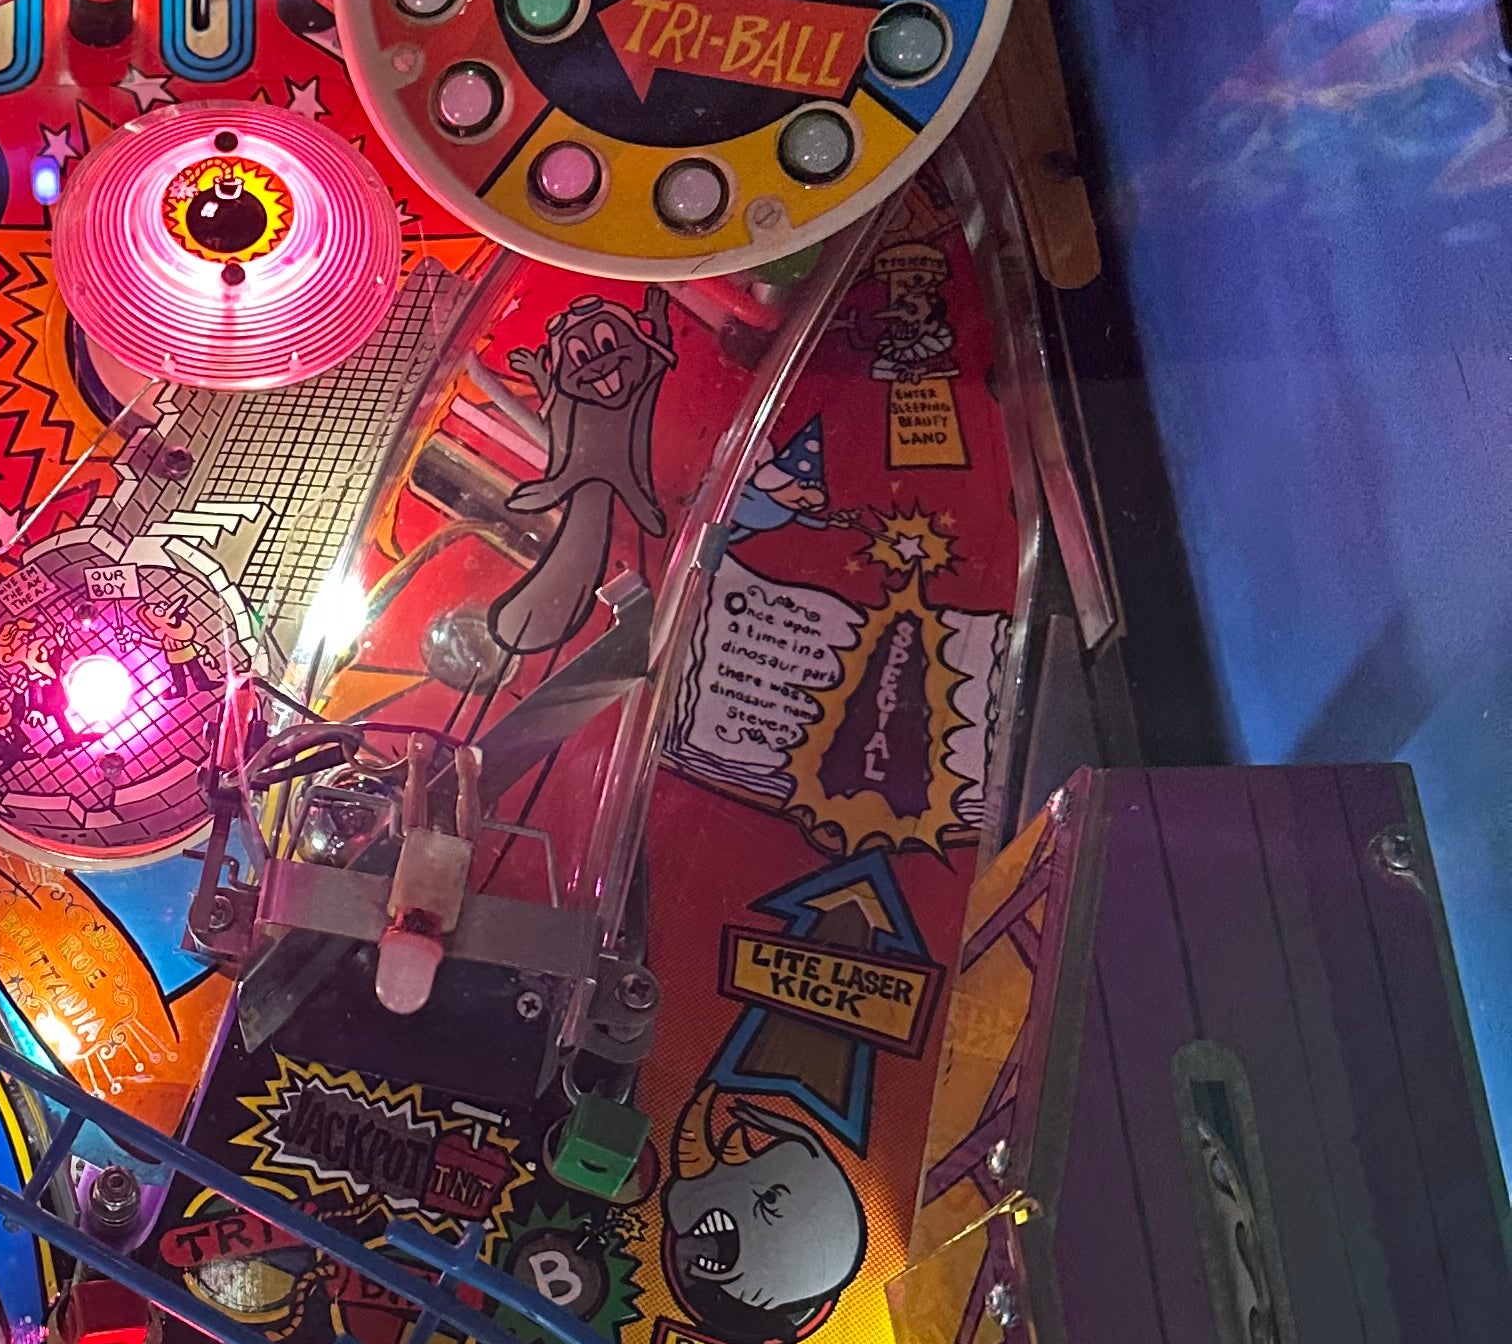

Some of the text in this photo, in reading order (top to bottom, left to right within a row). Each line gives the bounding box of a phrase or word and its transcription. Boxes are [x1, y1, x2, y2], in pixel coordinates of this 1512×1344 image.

[890, 402, 951, 415] SLEEPING
[895, 388, 937, 400] ENTER
[898, 416, 948, 428] BEAUTY
[898, 431, 948, 446] LAND
[3, 576, 43, 603] THE AX
[20, 566, 38, 584] EM
[90, 570, 128, 582] OUR
[91, 583, 126, 598] BOY
[11, 582, 50, 610] THE AX
[724, 591, 822, 637] Once upon
[727, 621, 825, 660] a time in a
[717, 662, 762, 688] there
[770, 680, 800, 701] was
[720, 640, 837, 686] dinosaur park
[709, 681, 777, 710] dinosaur
[863, 620, 915, 782] SPECIAL
[55, 933, 108, 990] RUE
[751, 943, 914, 1006] LITE LASER
[770, 972, 868, 1019] KICK
[434, 1164, 494, 1208] TNT
[176, 1217, 273, 1262] TRI
[529, 1250, 583, 1306] B
